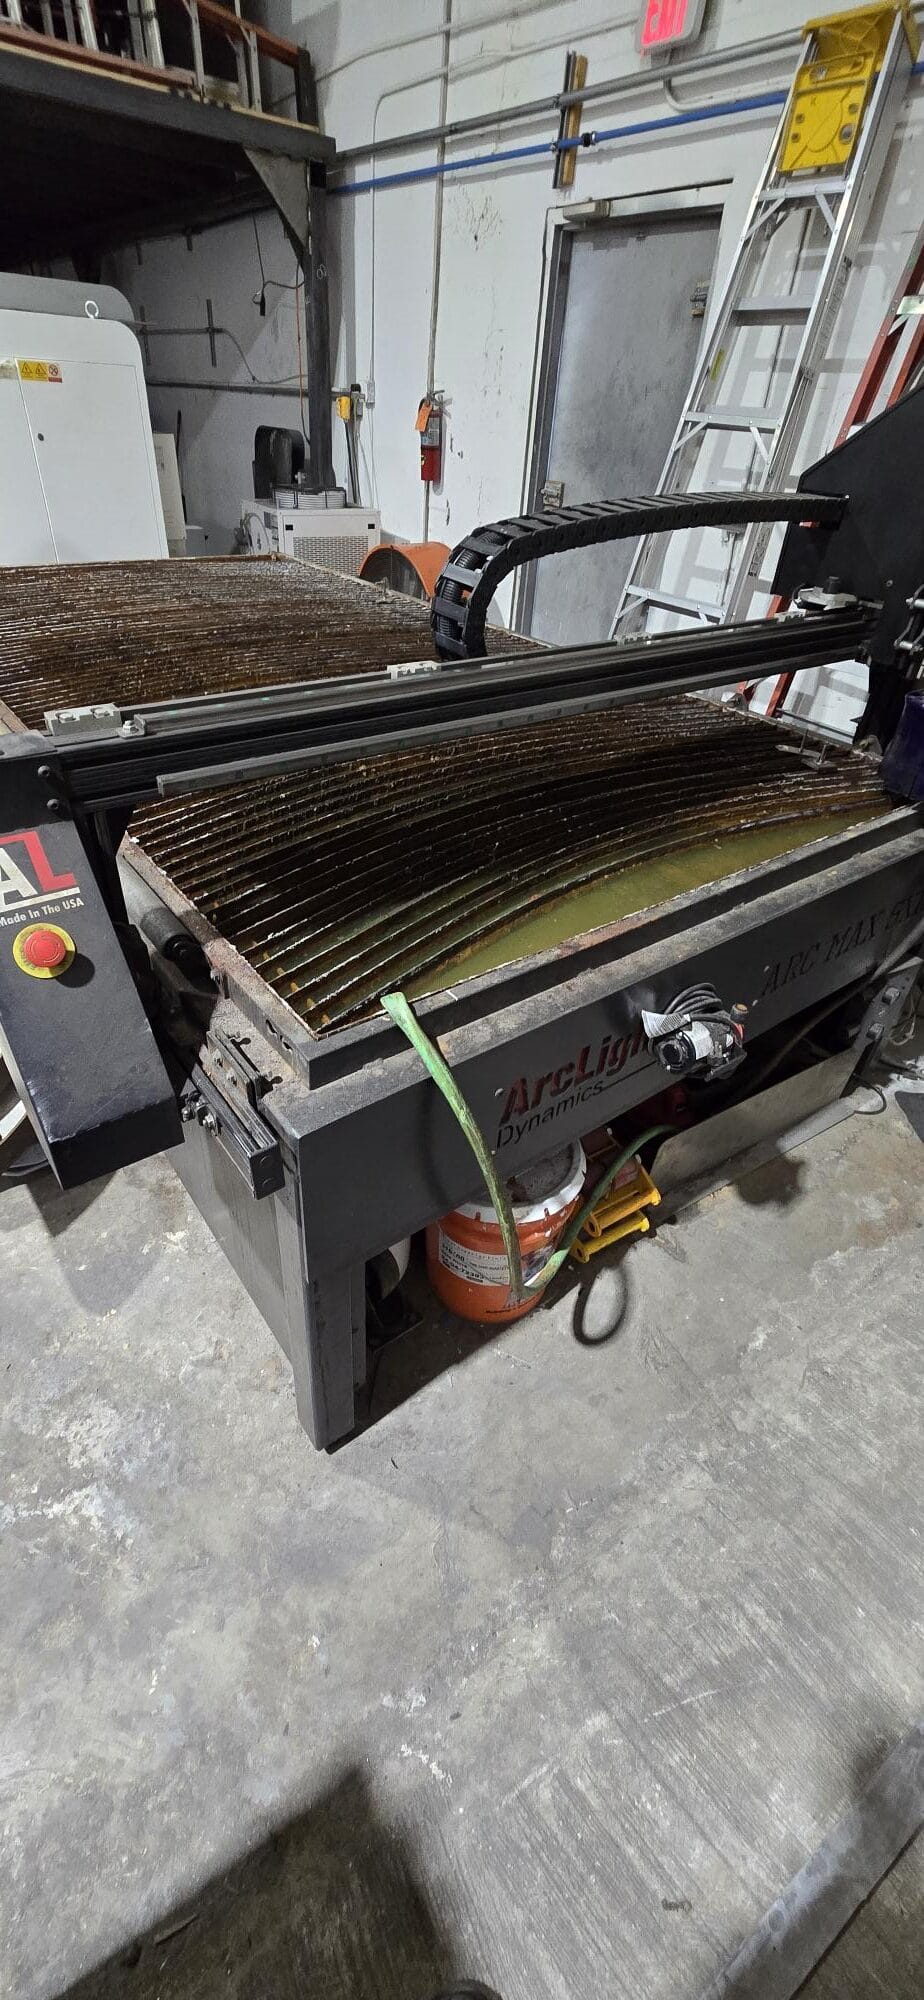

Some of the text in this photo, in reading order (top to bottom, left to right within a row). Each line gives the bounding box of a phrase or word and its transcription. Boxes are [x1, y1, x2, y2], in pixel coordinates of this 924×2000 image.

[0, 897, 85, 927] Made In The USA
[760, 942, 822, 997] ARC
[499, 1027, 651, 1126] ArcLigh
[496, 1080, 605, 1149] Dynamics
